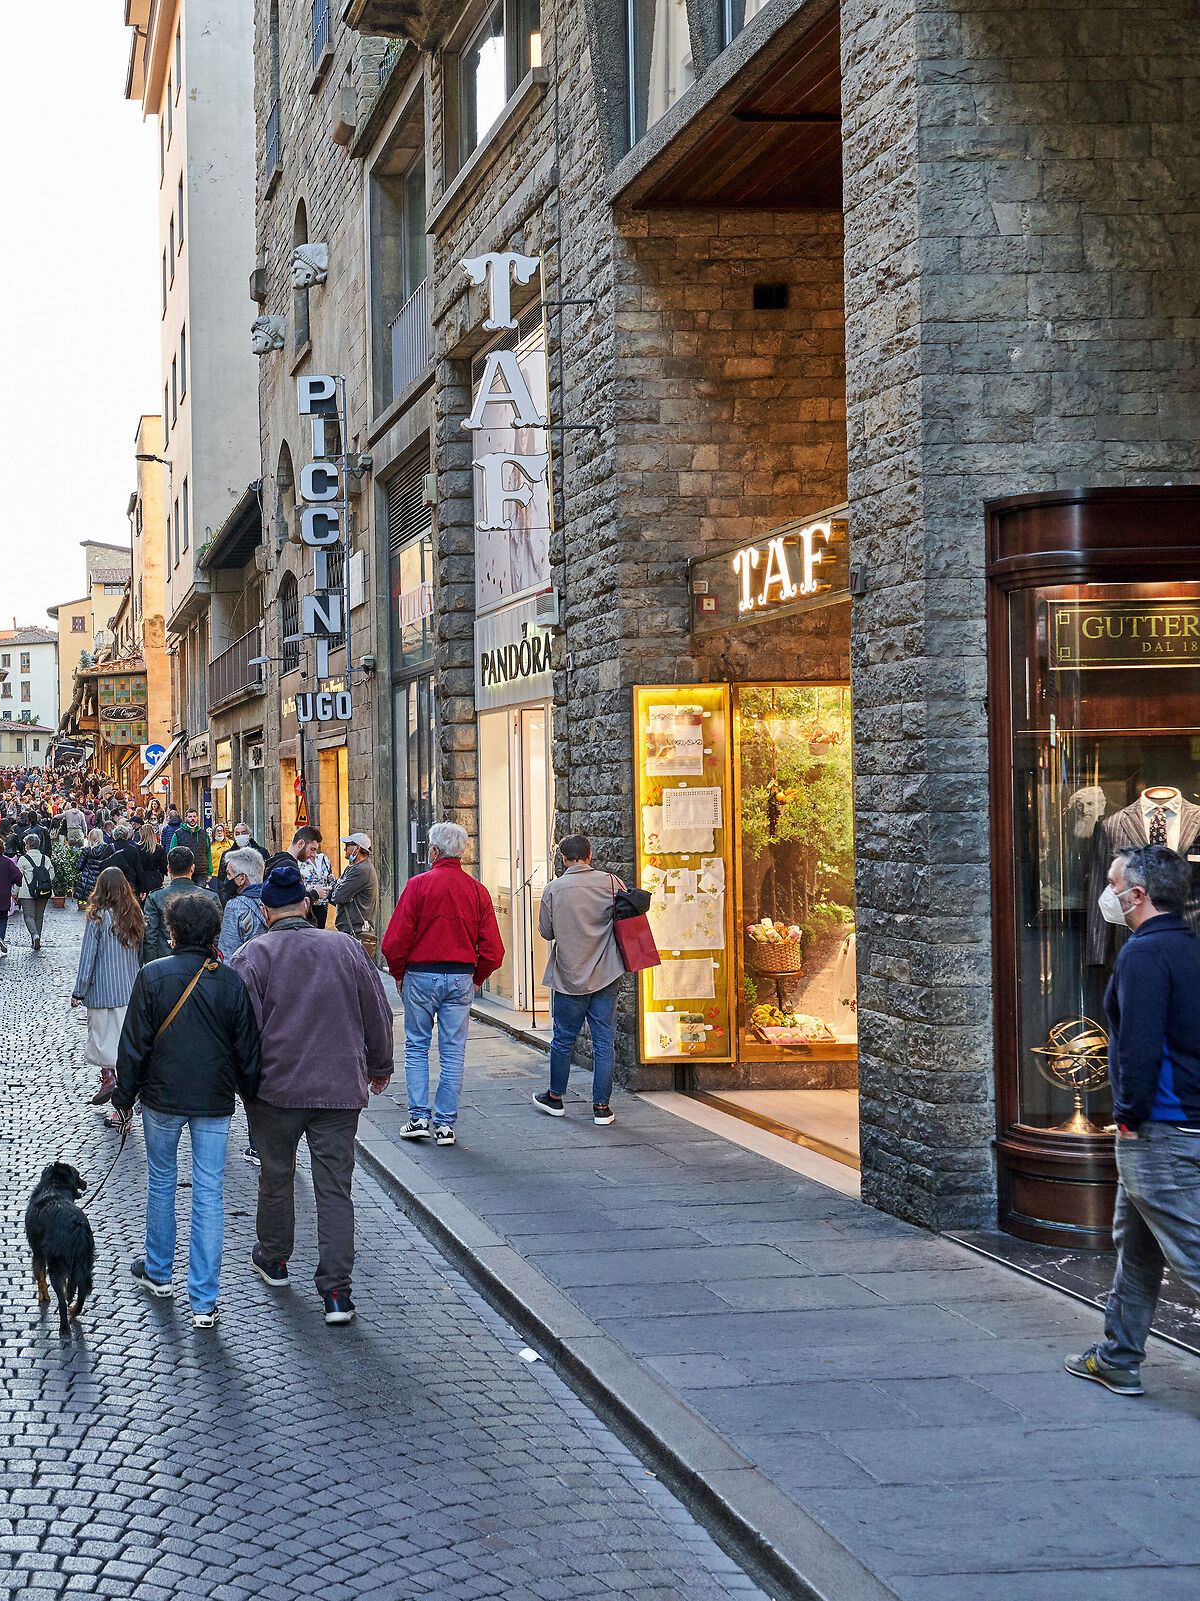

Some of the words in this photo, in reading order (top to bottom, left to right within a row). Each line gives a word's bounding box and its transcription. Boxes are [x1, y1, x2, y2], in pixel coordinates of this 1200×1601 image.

[460, 252, 549, 531] TAF
[298, 375, 341, 678] PICCINI
[733, 521, 831, 611] TAF
[1082, 615, 1200, 639] GUTTER
[1142, 642, 1175, 653] DAL
[1183, 641, 1198, 652] 18
[481, 632, 552, 687] PANDORA
[296, 691, 352, 722] UGO
